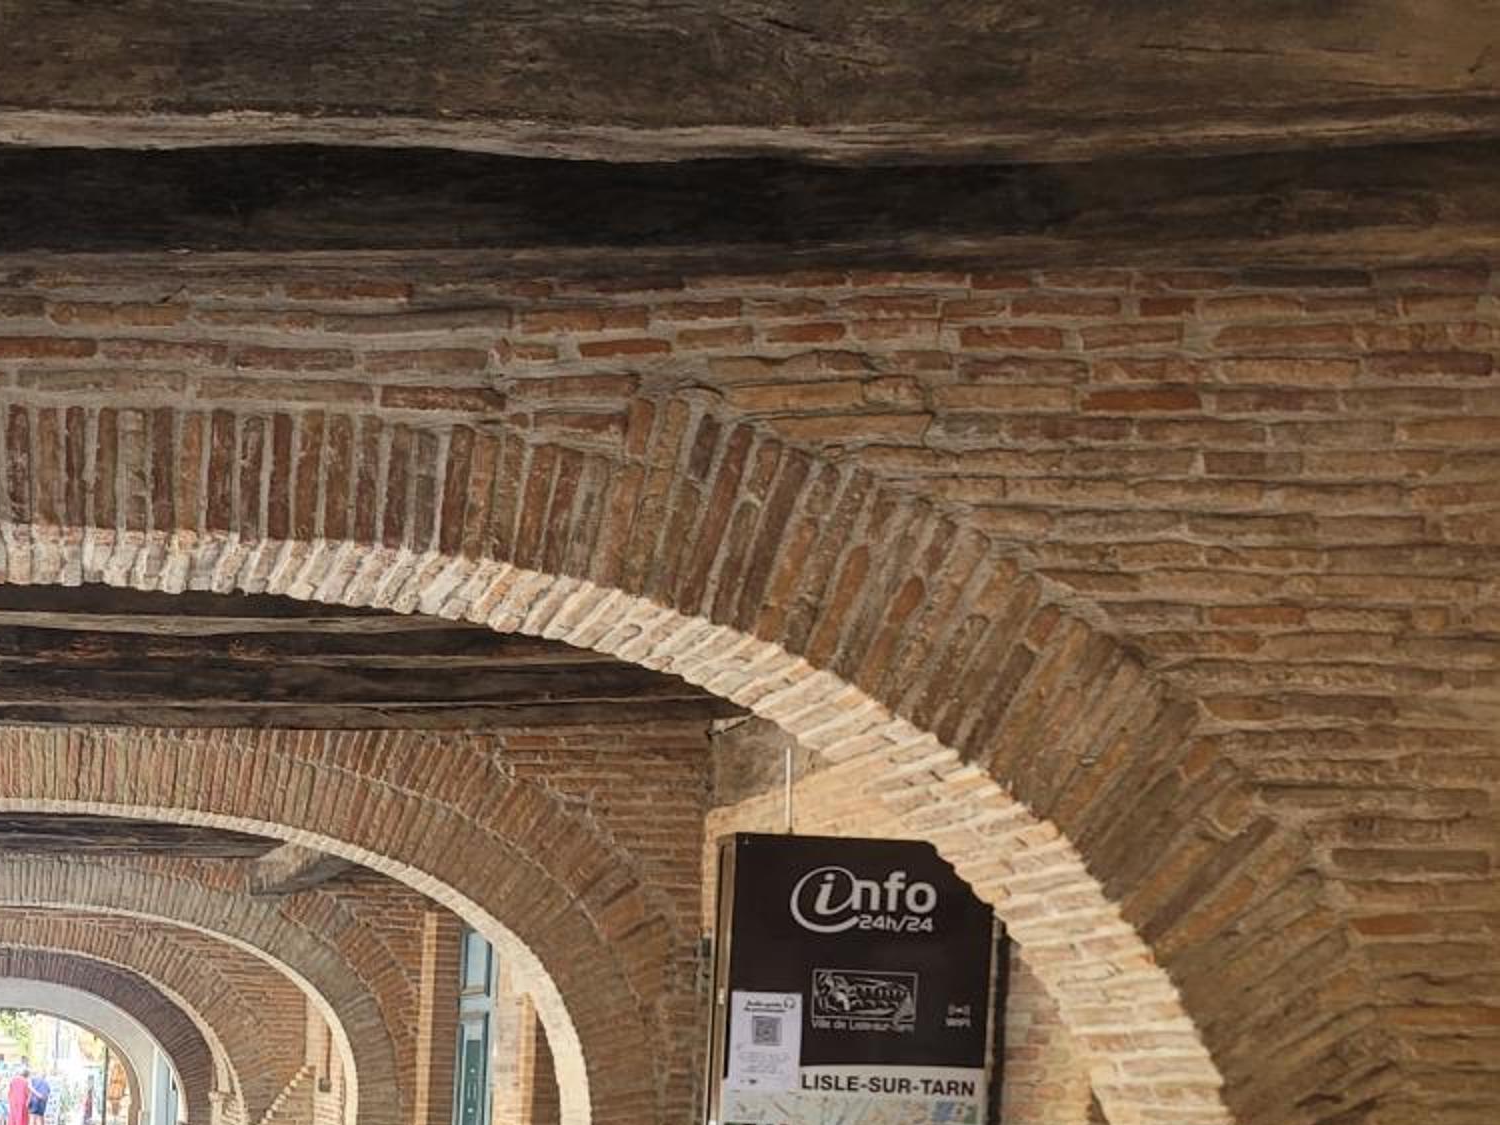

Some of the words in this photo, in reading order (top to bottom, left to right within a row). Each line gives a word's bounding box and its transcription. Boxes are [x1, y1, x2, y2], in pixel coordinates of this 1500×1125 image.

[790, 866, 937, 929] info
[858, 914, 933, 932] 24h/24
[800, 1073, 976, 1097] LISLE-SUR-TARN
